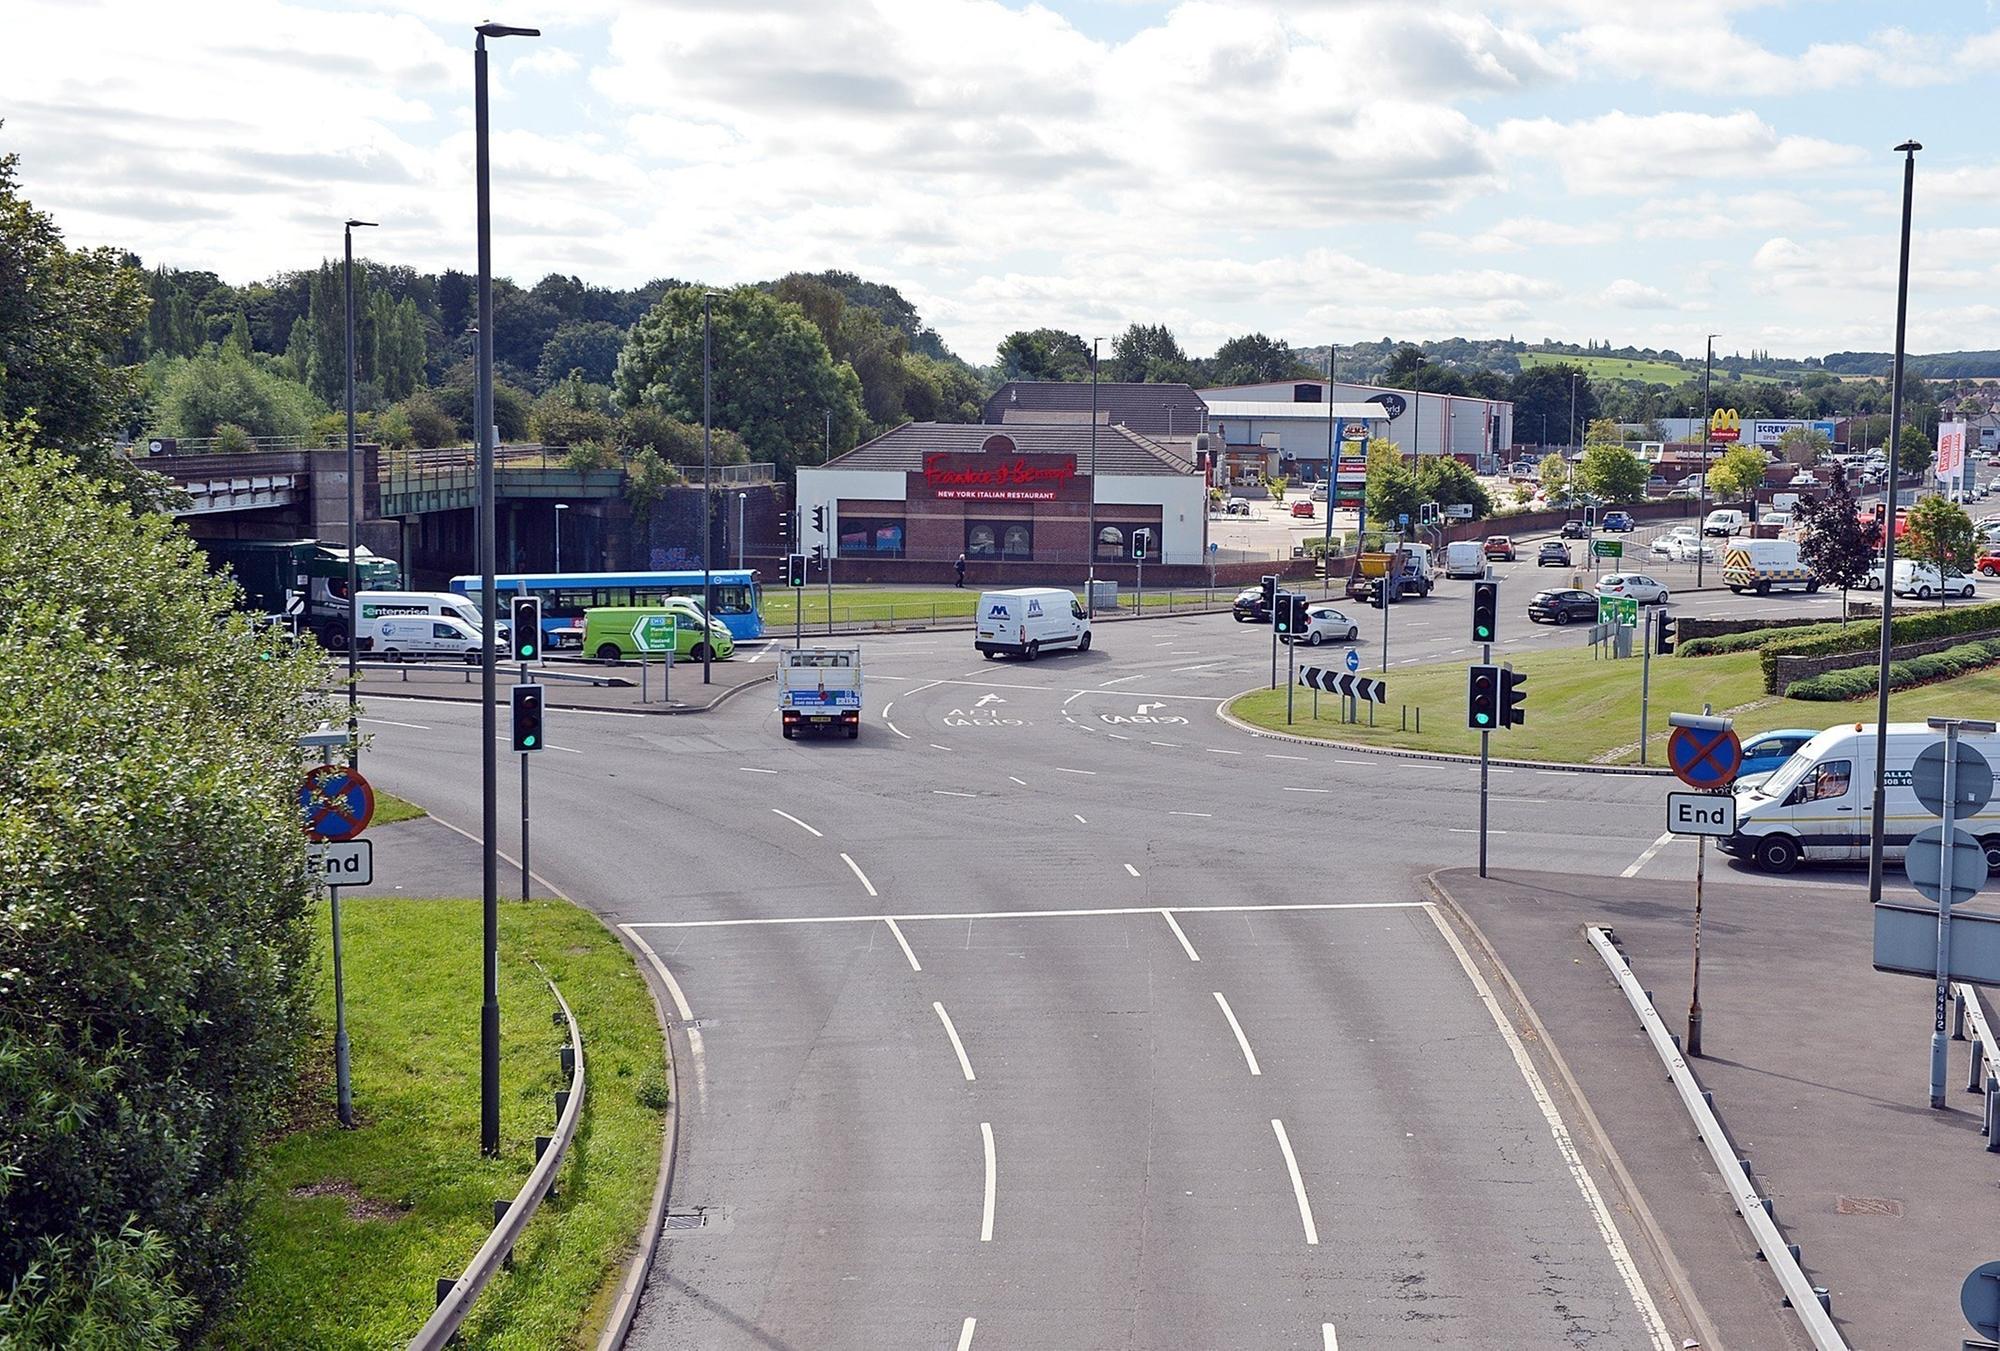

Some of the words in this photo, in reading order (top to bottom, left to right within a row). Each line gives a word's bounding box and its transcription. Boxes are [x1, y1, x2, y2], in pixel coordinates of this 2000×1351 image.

[1757, 425, 1800, 434] SCREW
[924, 453, 992, 487] Frankie
[1011, 458, 1074, 488] Benny's
[363, 602, 428, 616] enterprise
[1679, 803, 1725, 825] End
